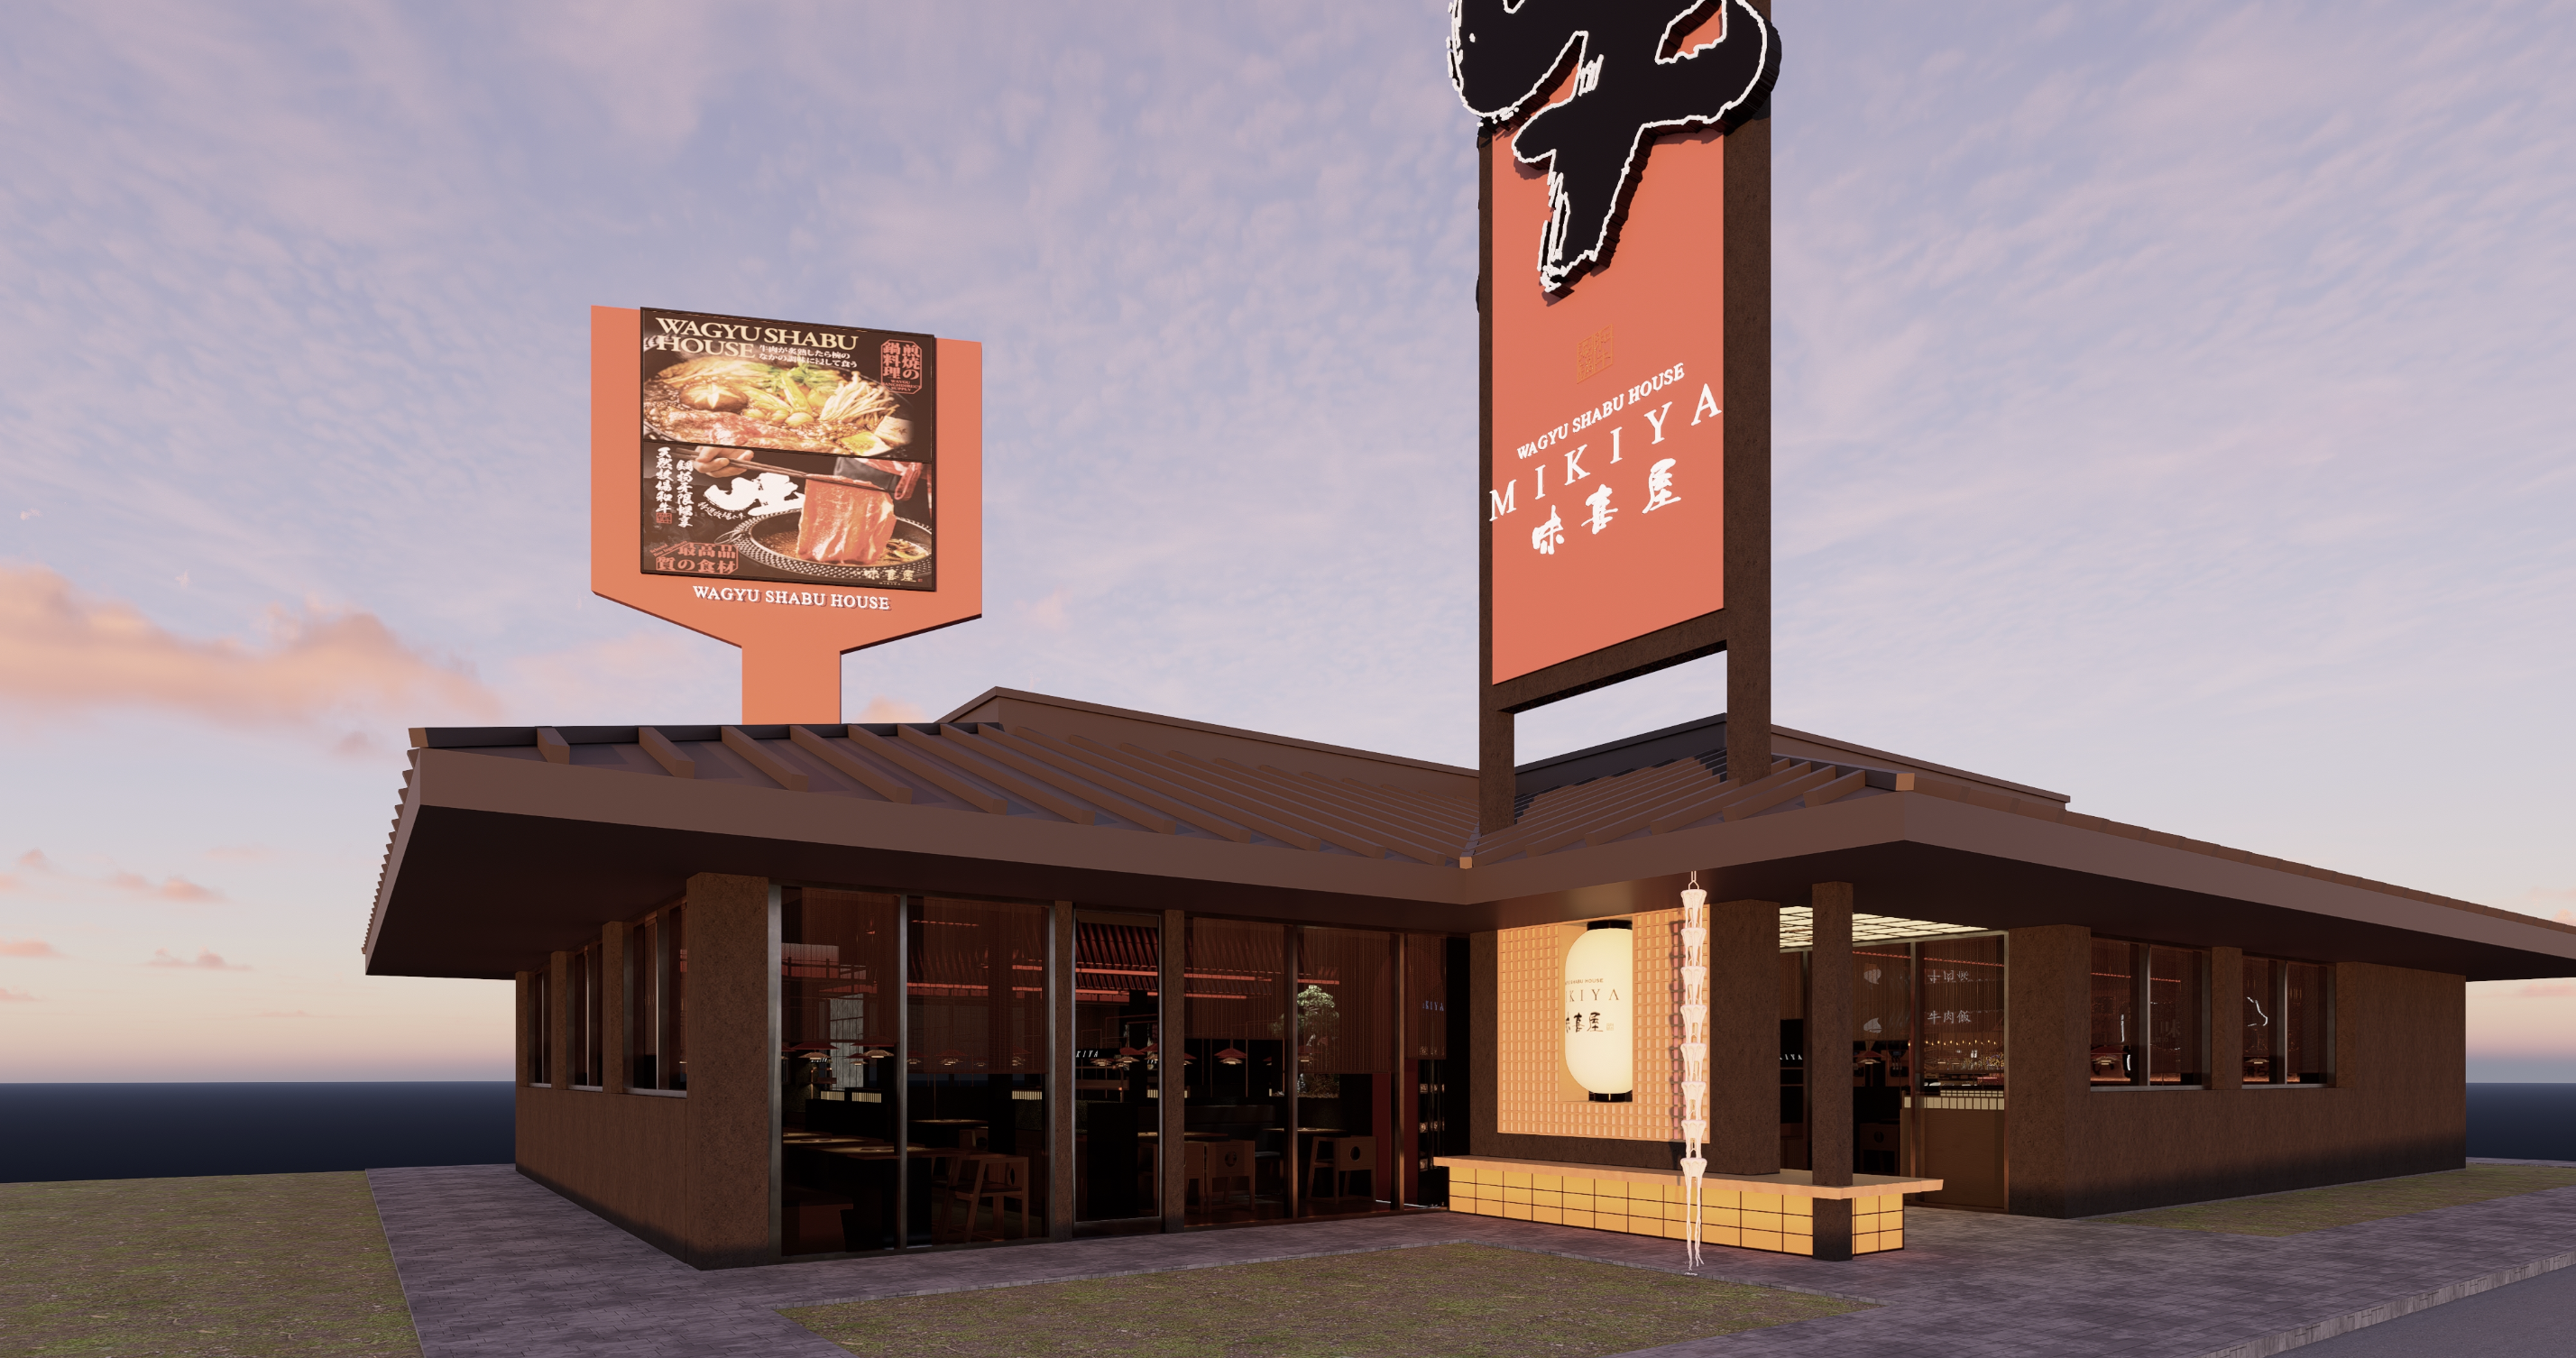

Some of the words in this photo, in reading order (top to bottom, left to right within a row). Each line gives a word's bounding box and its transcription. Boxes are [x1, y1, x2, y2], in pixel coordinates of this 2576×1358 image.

[656, 317, 762, 342] WAGYU
[764, 328, 858, 351] SHABU
[657, 335, 756, 359] HOUSE
[883, 342, 901, 380] 鍋料理
[1516, 423, 1569, 460] WAGYU
[1572, 394, 1624, 433] SHABU
[1627, 362, 1685, 405] HOUSE
[1489, 383, 1722, 522] MIKIYA
[677, 543, 736, 559] 最高品
[658, 556, 736, 574] 質の食材
[692, 585, 759, 602] WAGYU
[765, 591, 825, 606] SHABU
[831, 595, 890, 610] HOUSE
[1565, 988, 1620, 1003] IKIYA
[1927, 1009, 1972, 1025] 牛肉飯
[1075, 1050, 1099, 1058] KIYA
